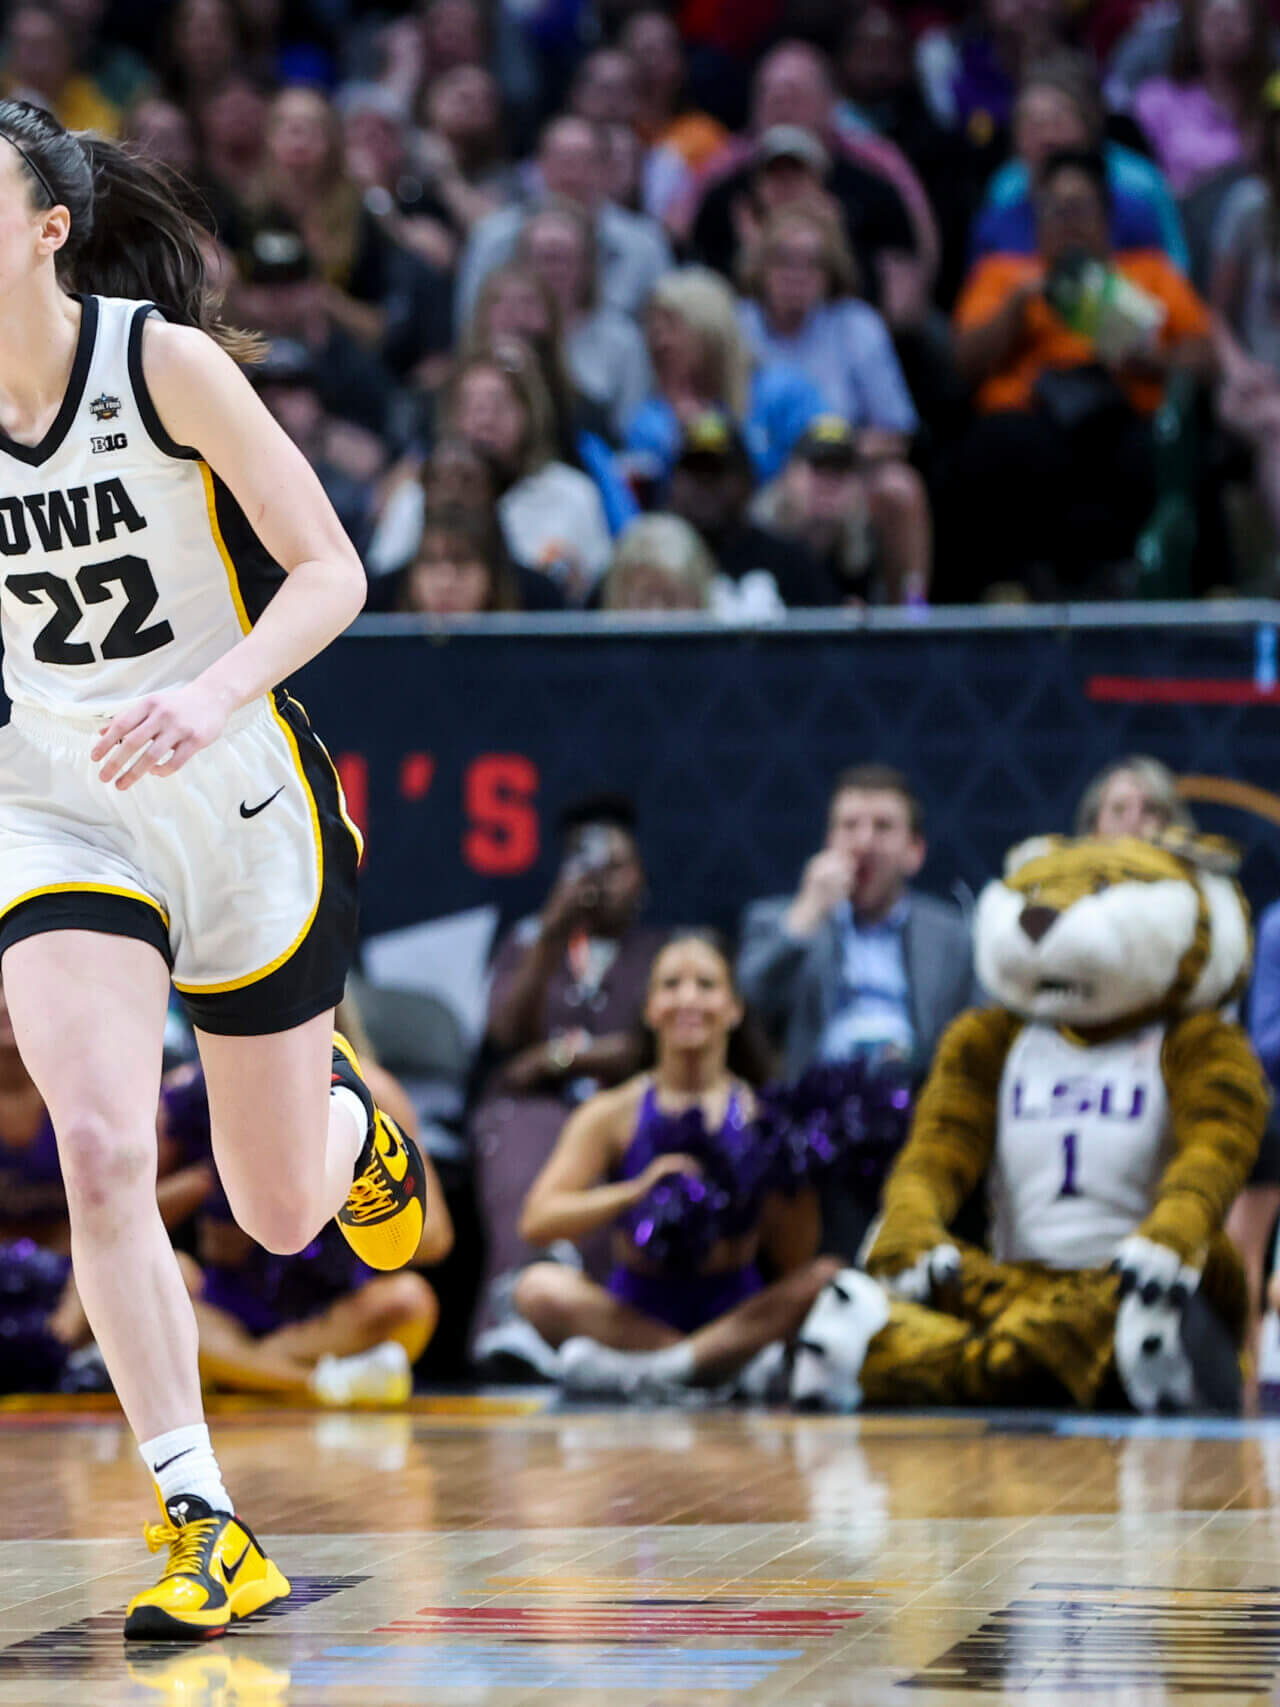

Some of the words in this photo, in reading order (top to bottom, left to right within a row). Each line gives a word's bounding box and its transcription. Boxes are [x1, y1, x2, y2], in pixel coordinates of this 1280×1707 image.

[4, 554, 175, 665] 22
[1013, 1078, 1146, 1121] LSU
[1057, 1132, 1084, 1197] 1
